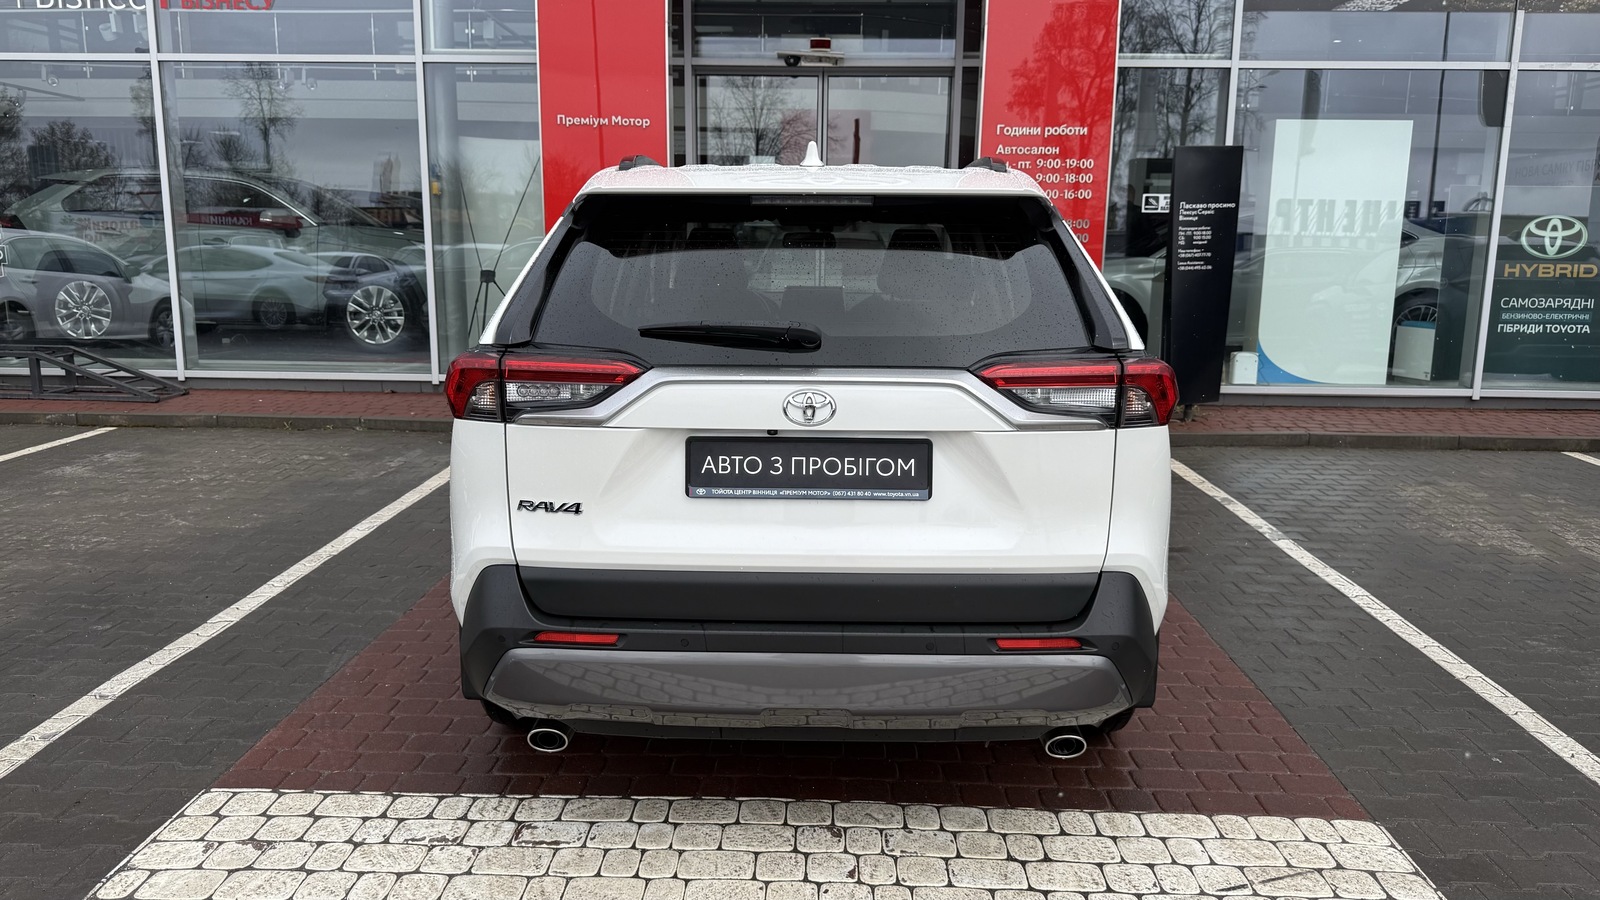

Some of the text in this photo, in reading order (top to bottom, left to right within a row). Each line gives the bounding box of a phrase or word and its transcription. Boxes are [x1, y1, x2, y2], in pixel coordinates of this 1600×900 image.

[556, 114, 651, 129] Преміум Мотор
[996, 124, 1088, 138] Години роботи
[996, 144, 1060, 155] Автосалон
[1036, 158, 1095, 169] 9:00-19:00
[1035, 173, 1093, 184] 9:00-18:00
[1179, 201, 1207, 209] Ласкаво
[1208, 202, 1236, 210] просимо
[1503, 263, 1598, 278] HYBRID
[1500, 297, 1595, 310] САМОЗАРЯДНІ
[1501, 312, 1590, 320] БЕНЗИНОВО-ЕЛЕКТРИЧНІ
[1497, 323, 1591, 334] ГІБРИДИ TOYOTA
[701, 455, 916, 477] АВТО З ПРОБІГОМ
[517, 500, 583, 515] RAV4
